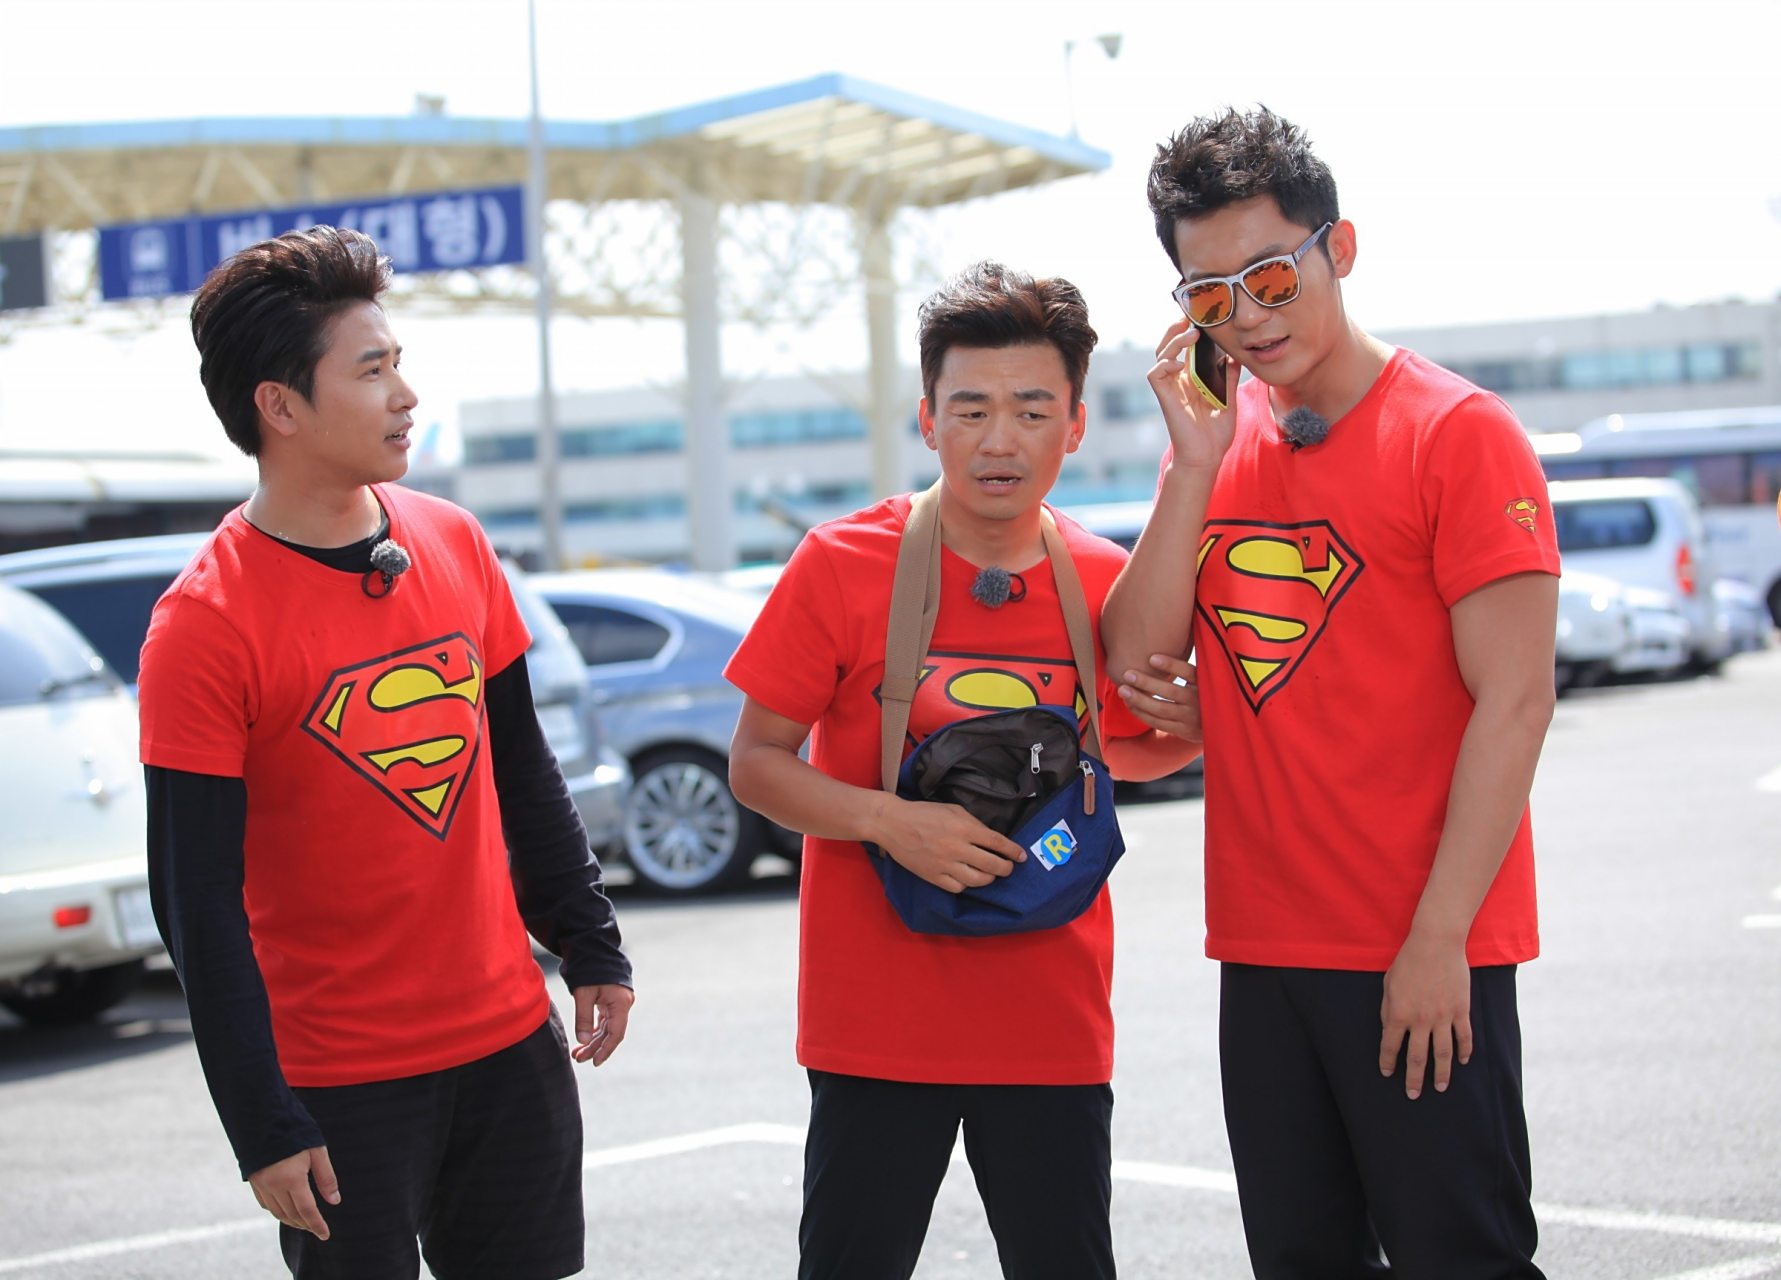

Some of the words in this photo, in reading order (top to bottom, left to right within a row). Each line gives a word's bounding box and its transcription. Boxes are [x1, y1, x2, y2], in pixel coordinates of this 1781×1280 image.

[1198, 523, 1355, 705] S
[310, 637, 480, 830] S
[1044, 834, 1070, 862] R
